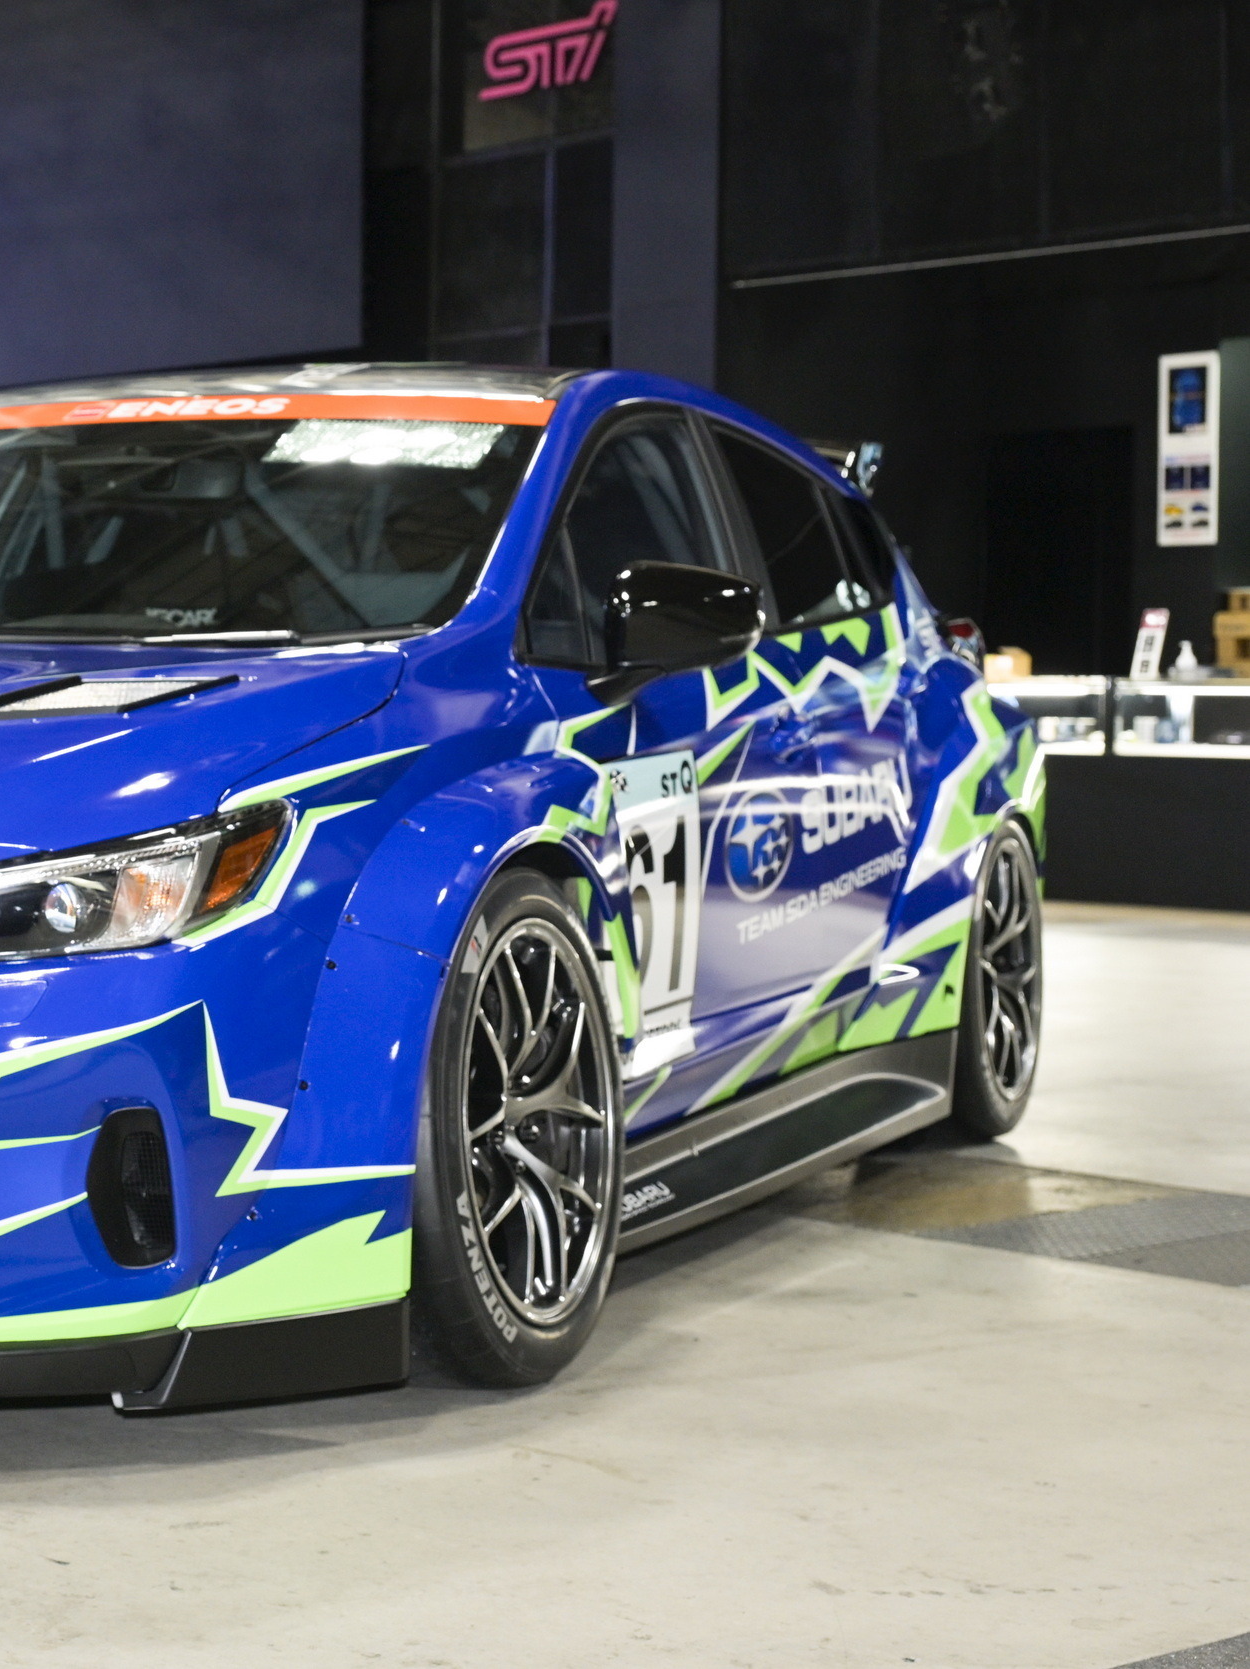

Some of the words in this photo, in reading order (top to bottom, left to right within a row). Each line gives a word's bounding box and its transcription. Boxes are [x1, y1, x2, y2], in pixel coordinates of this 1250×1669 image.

[107, 397, 291, 418] ENEOS
[801, 751, 913, 854] SUBARU
[736, 905, 785, 944] TEAM
[785, 889, 819, 924] SDA
[818, 846, 907, 906] ENGINEERING
[621, 1181, 671, 1212] UBARU
[456, 1190, 518, 1344] POTENZA
